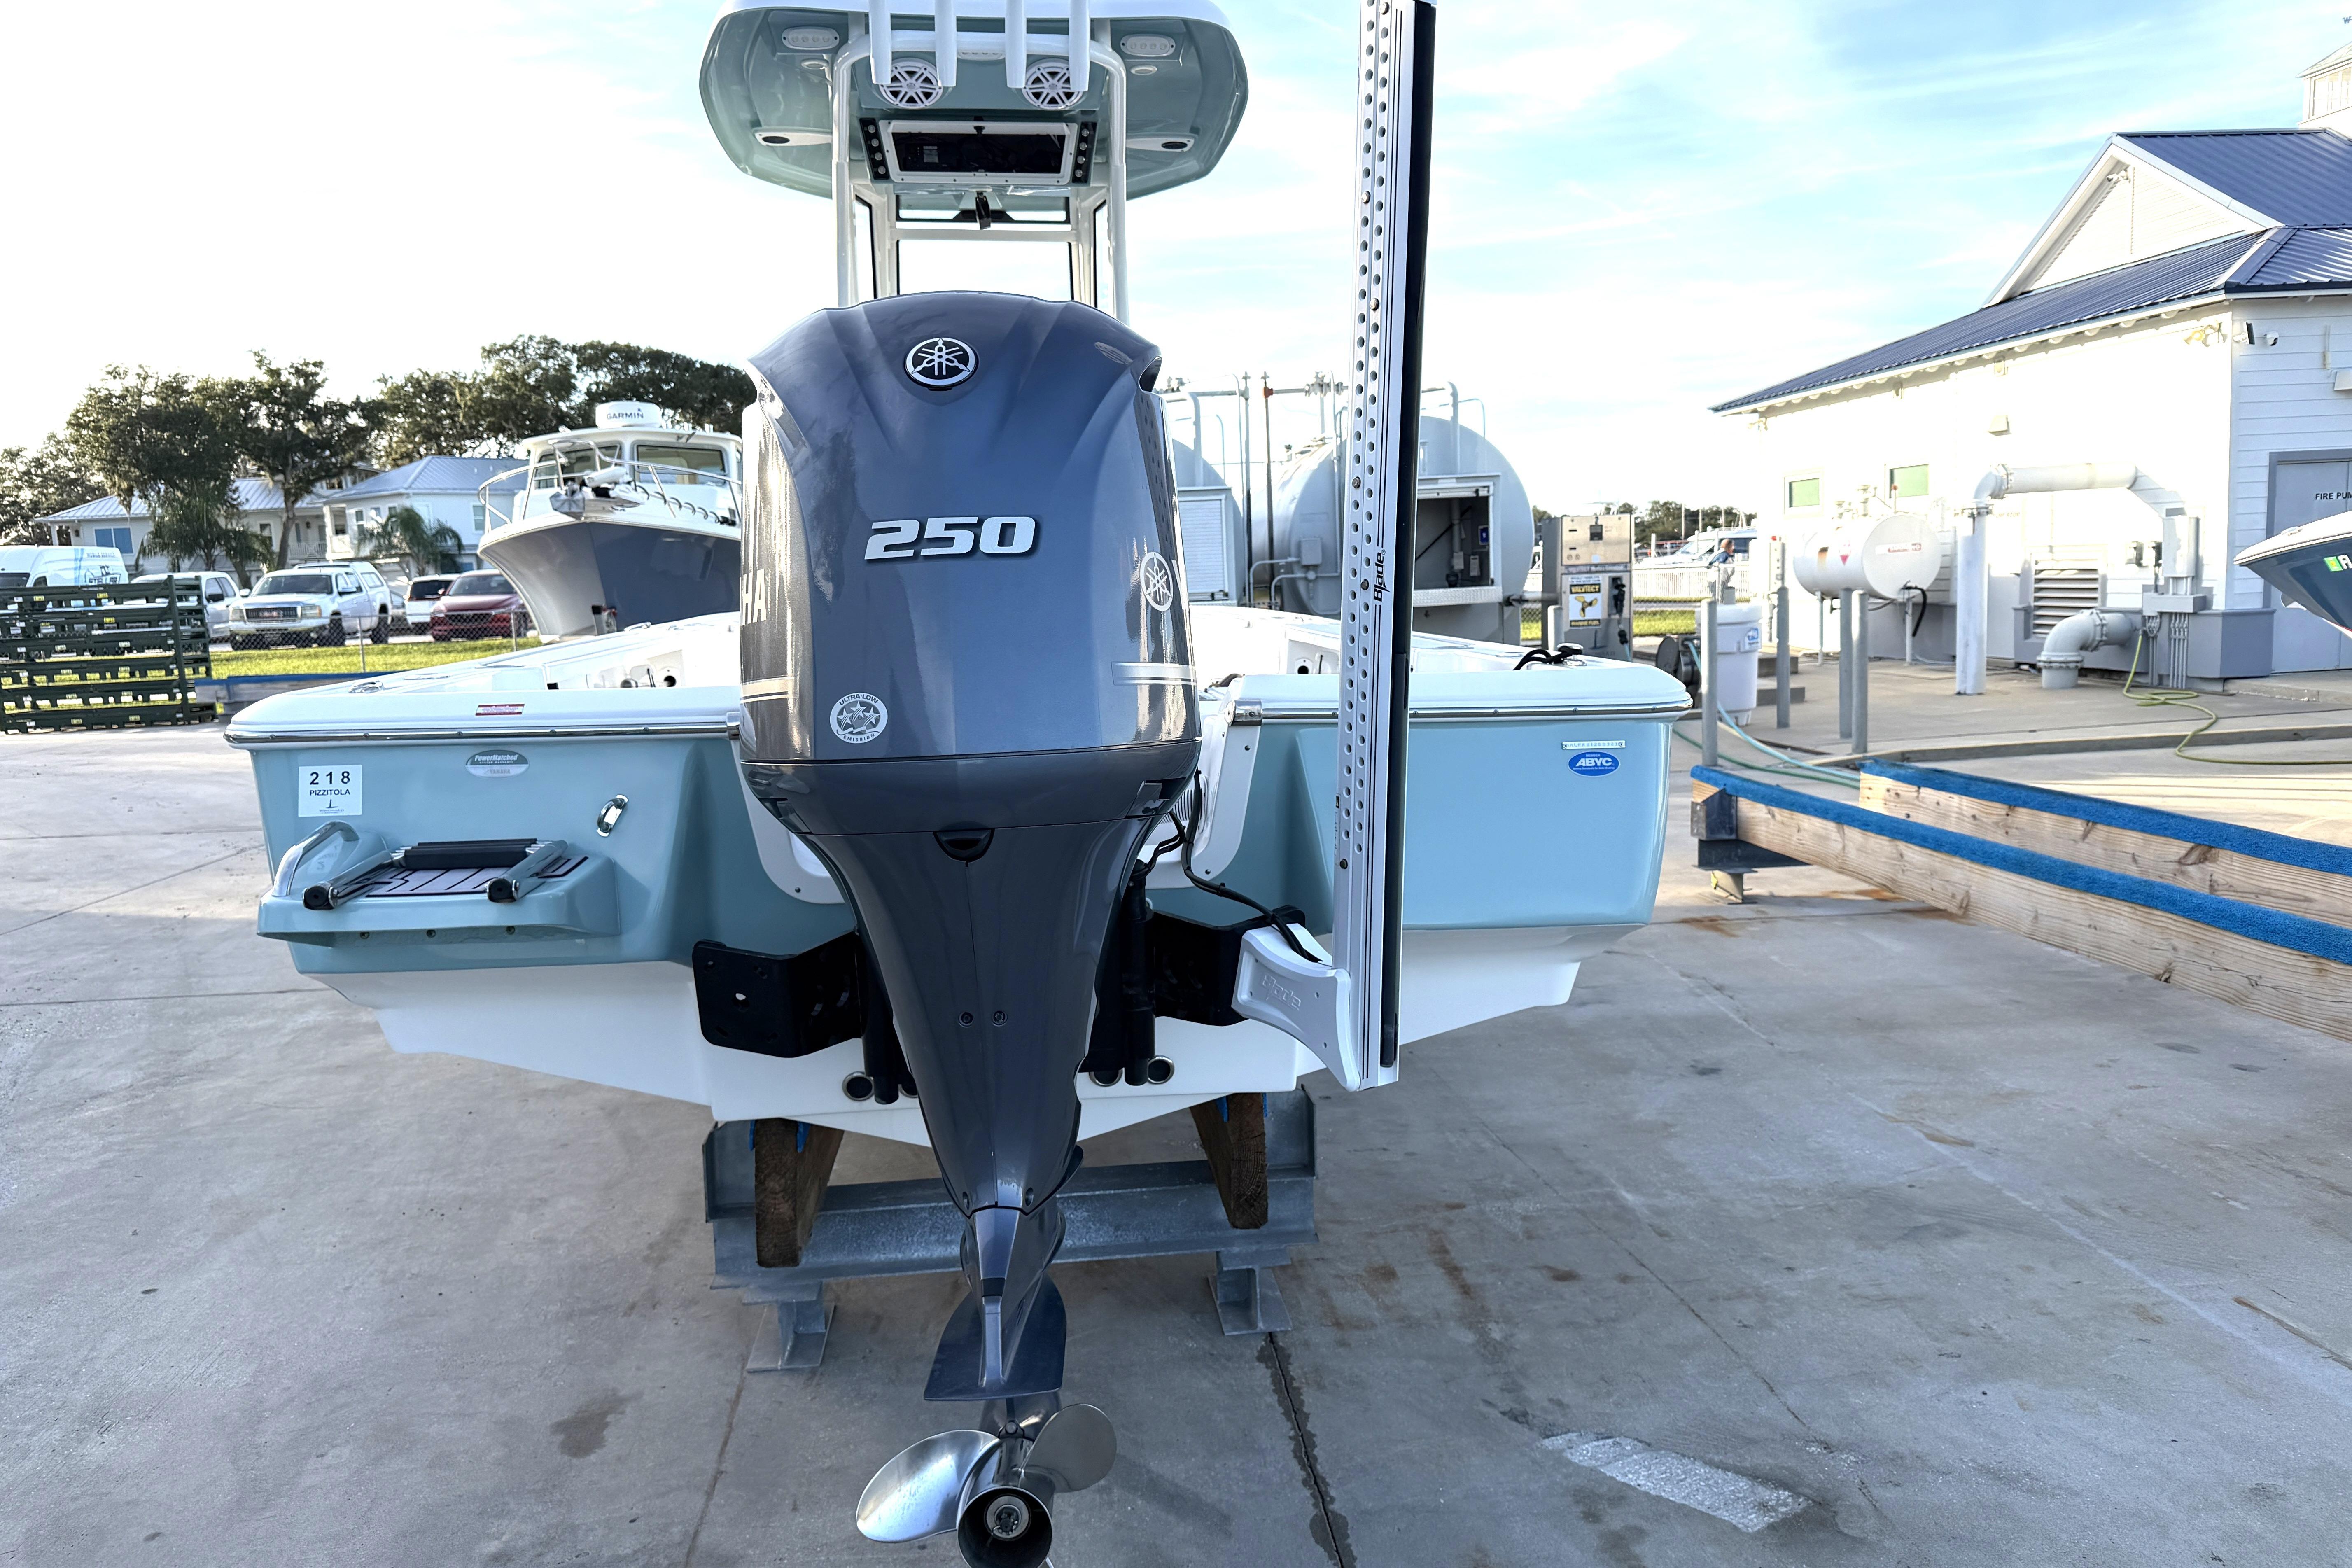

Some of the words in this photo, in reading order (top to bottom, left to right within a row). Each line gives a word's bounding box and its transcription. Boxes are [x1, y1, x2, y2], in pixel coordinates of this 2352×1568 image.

[864, 516, 1036, 560] 250
[843, 733, 875, 742] EMISSION
[1575, 757, 1612, 767] ABYC
